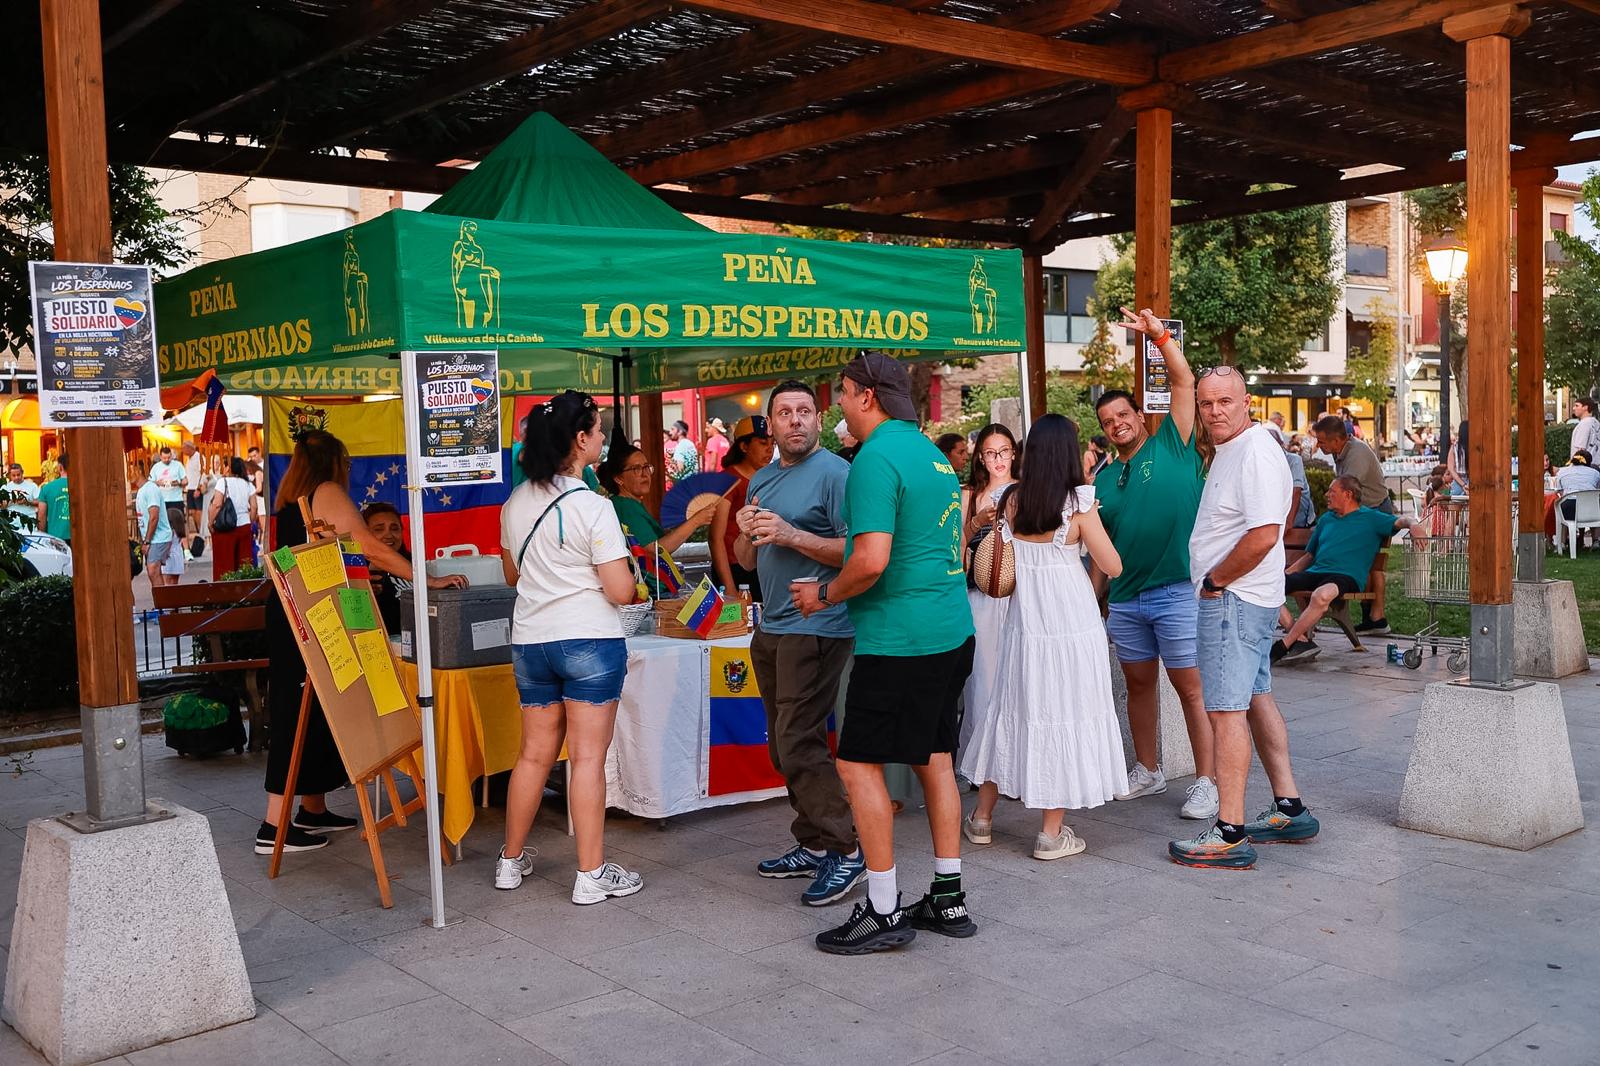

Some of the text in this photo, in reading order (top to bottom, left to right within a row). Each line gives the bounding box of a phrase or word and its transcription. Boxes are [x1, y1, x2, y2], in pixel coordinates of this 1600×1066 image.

[723, 247, 817, 285] PEÑA
[51, 279, 133, 292] LOS DESPERNAOS
[189, 276, 237, 318] PEÑA
[52, 300, 108, 316] PUESTO
[51, 315, 117, 330] SOLIDARIO
[581, 302, 929, 342] LOS DESPERNAOS
[173, 318, 313, 373] DESPERNAOS
[424, 332, 545, 345] Villanueva de la Cañada
[427, 363, 485, 376] LOS DESPERNAOS
[427, 381, 467, 396] PUESTO
[427, 393, 474, 408] SOLIDARIO
